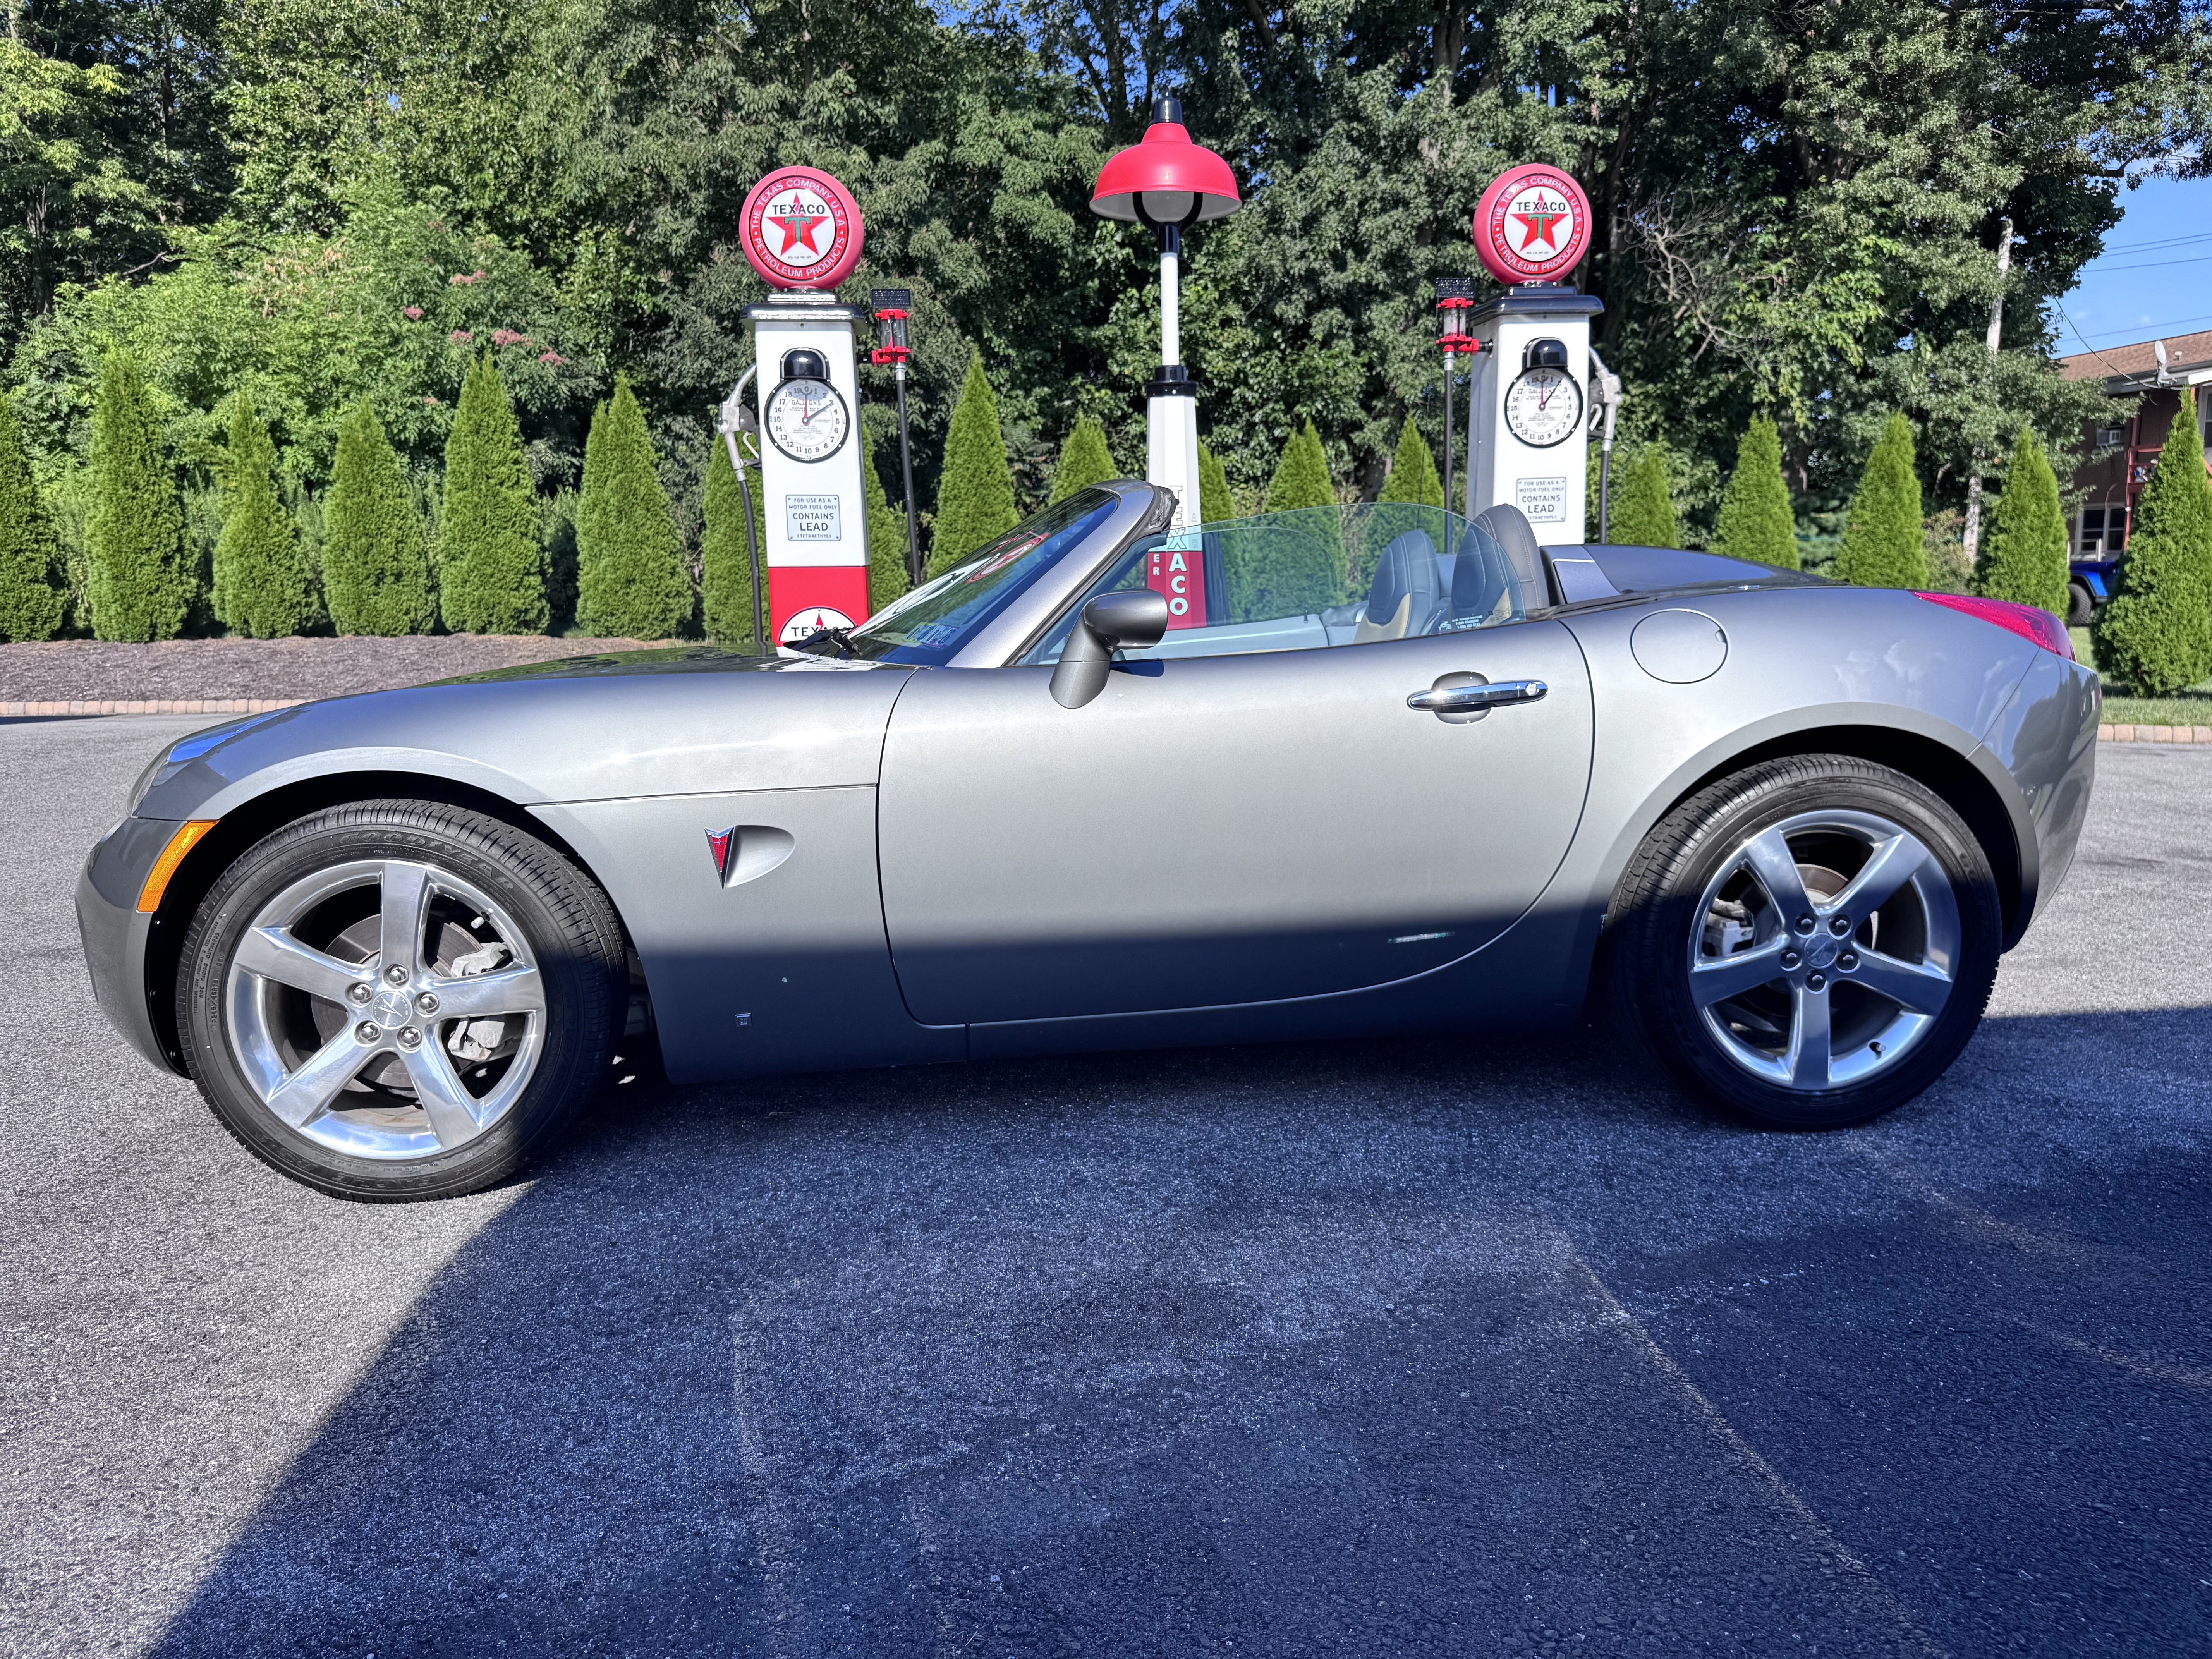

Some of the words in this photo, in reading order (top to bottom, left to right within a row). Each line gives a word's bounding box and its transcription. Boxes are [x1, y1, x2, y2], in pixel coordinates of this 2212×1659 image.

[752, 210, 761, 229] THE
[757, 182, 784, 206] TEXAS
[786, 179, 833, 199] COMPANY
[772, 204, 825, 215] TEXACO
[1493, 206, 1503, 226] THE
[1530, 178, 1572, 198] COMPANY
[1516, 201, 1566, 212] TEXACO
[754, 238, 803, 277] PETROLEUM
[806, 237, 845, 276] PRODUCTS
[1494, 234, 1539, 271] PETROLEUM
[1541, 234, 1579, 271] PRODUCTS
[1522, 494, 1560, 503] CONTAINS
[1528, 504, 1554, 513] LEAD
[800, 522, 828, 531] LEAD
[340, 831, 515, 891] GOODYEAR
